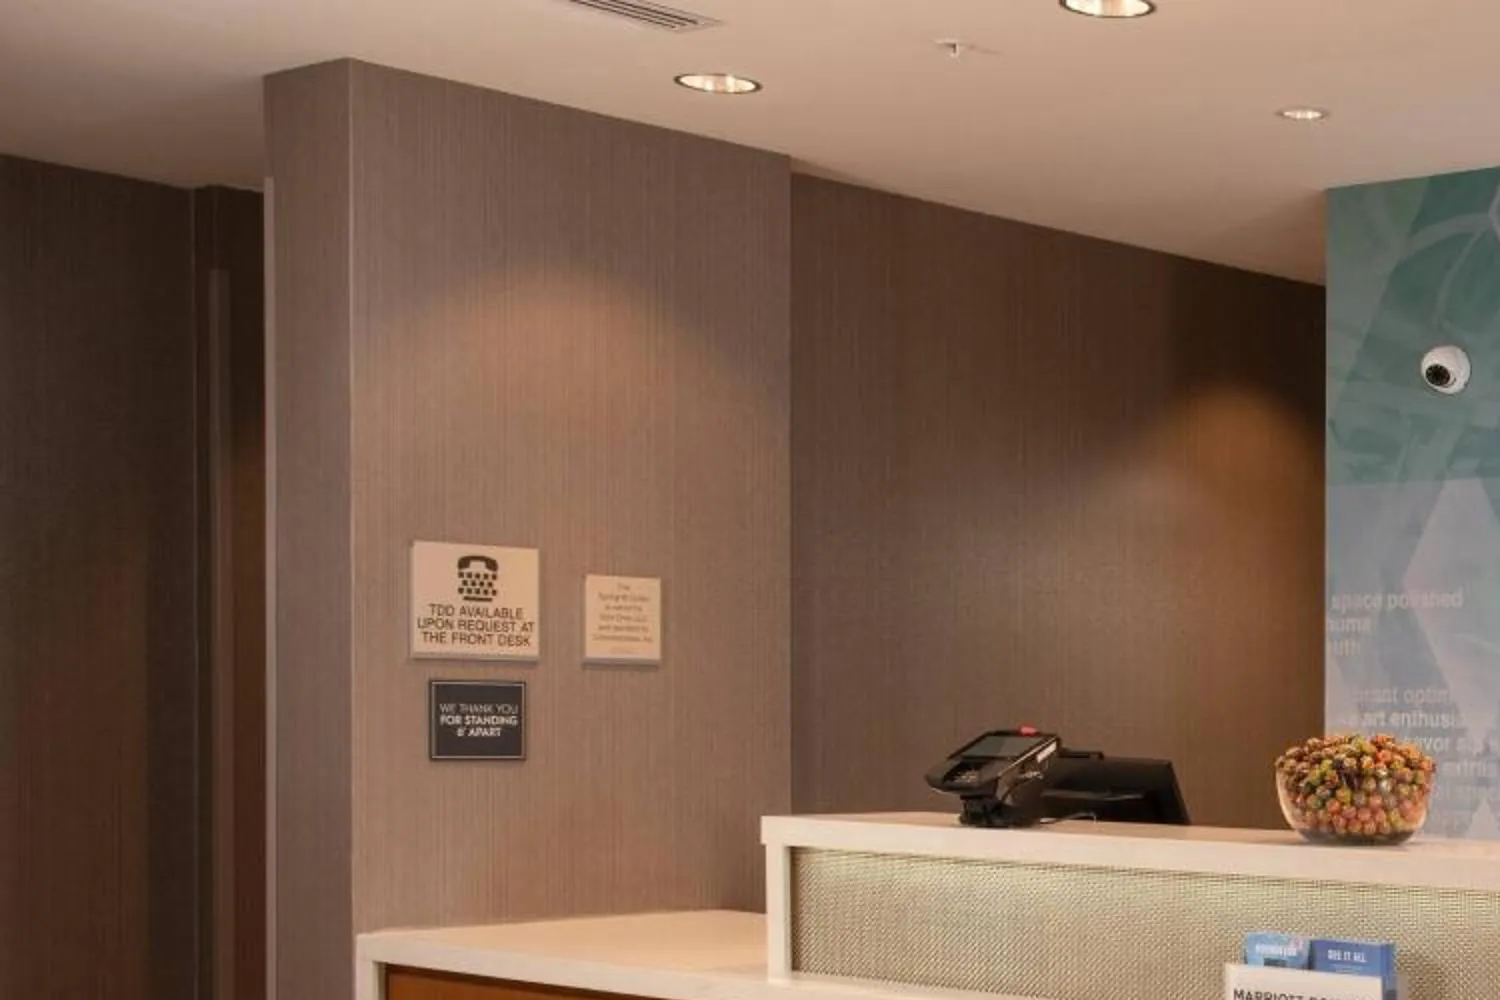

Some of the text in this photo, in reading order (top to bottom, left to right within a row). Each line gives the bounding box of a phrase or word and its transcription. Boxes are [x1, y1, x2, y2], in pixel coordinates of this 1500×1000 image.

[429, 603, 524, 620] TDD AVAILABLE
[417, 617, 535, 634] UPON REQUEST AT
[422, 631, 532, 648] THE FRONT DESK
[496, 703, 519, 715] YOU
[440, 715, 518, 727] FOR STANDING
[468, 727, 502, 738] APART
